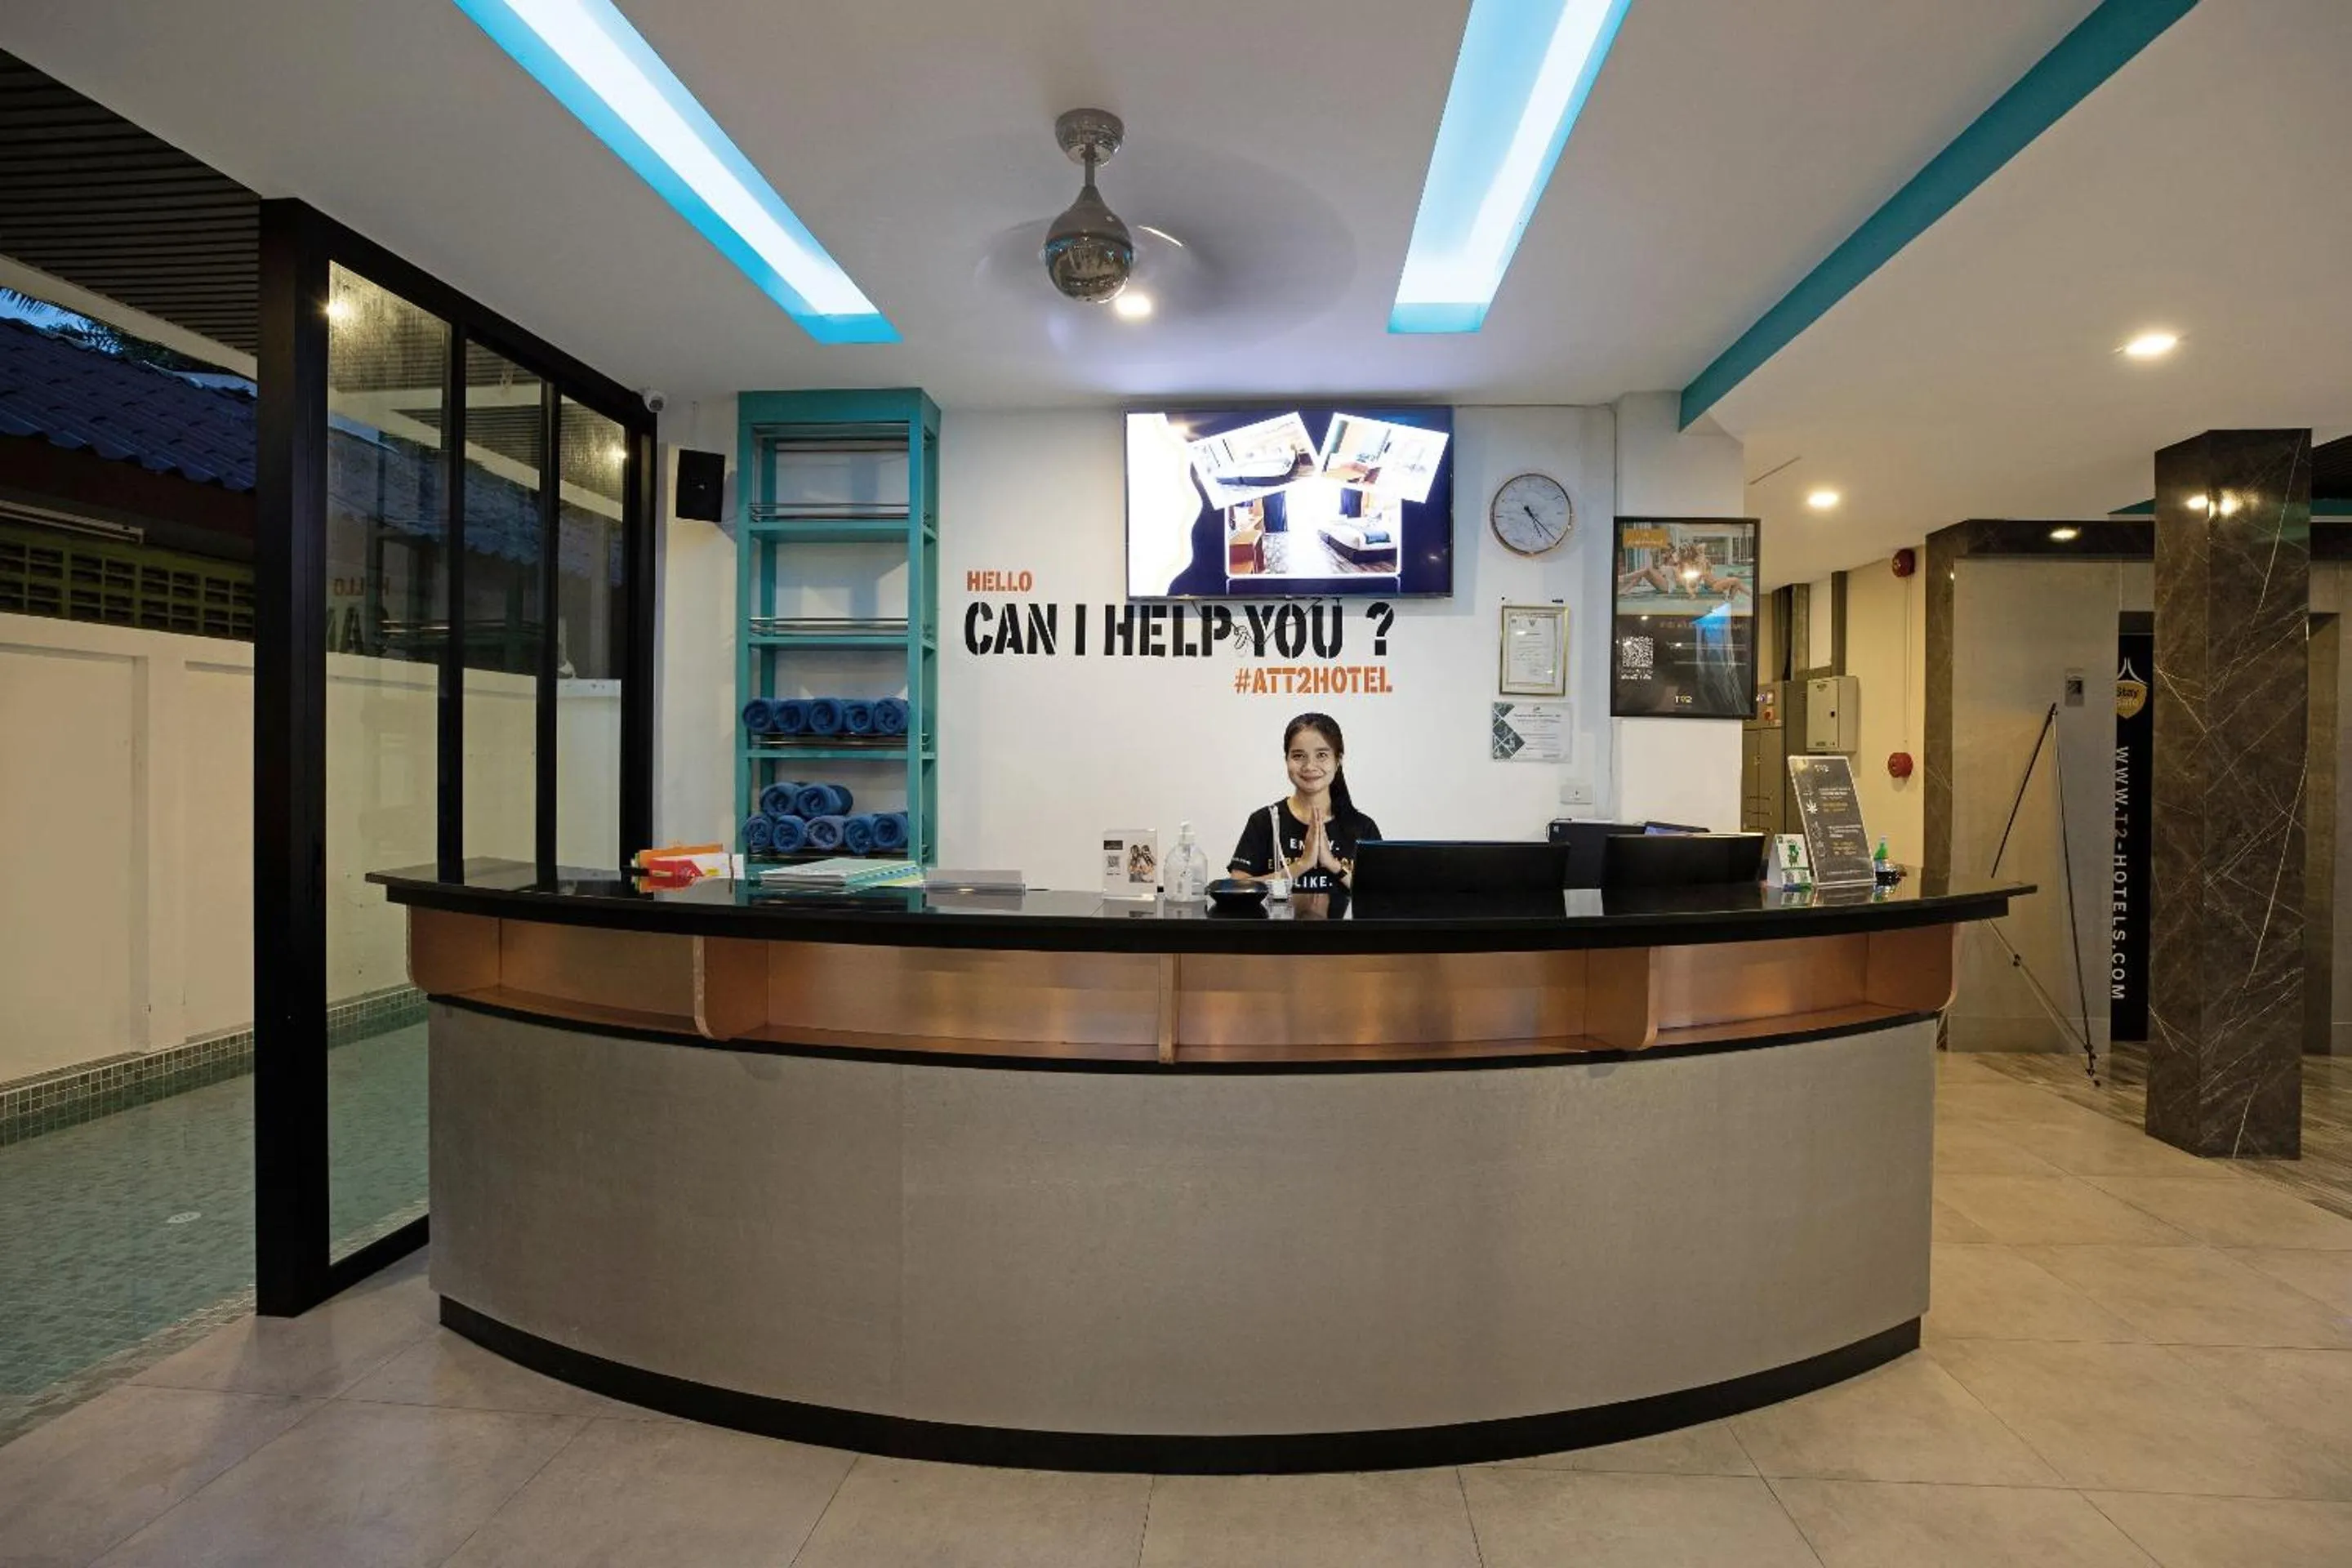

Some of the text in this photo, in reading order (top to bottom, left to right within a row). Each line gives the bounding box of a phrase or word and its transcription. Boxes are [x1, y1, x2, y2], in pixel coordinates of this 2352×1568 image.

[966, 570, 1032, 592] HELLO
[964, 601, 1395, 658] CAN I HELP YOU ?
[1235, 666, 1393, 693] #ATT2HOTEL
[1290, 838, 1340, 851] ENY.
[1294, 875, 1333, 888] LIKE.
[2111, 746, 2129, 1000] WWW.T2-HOTELS.COM
